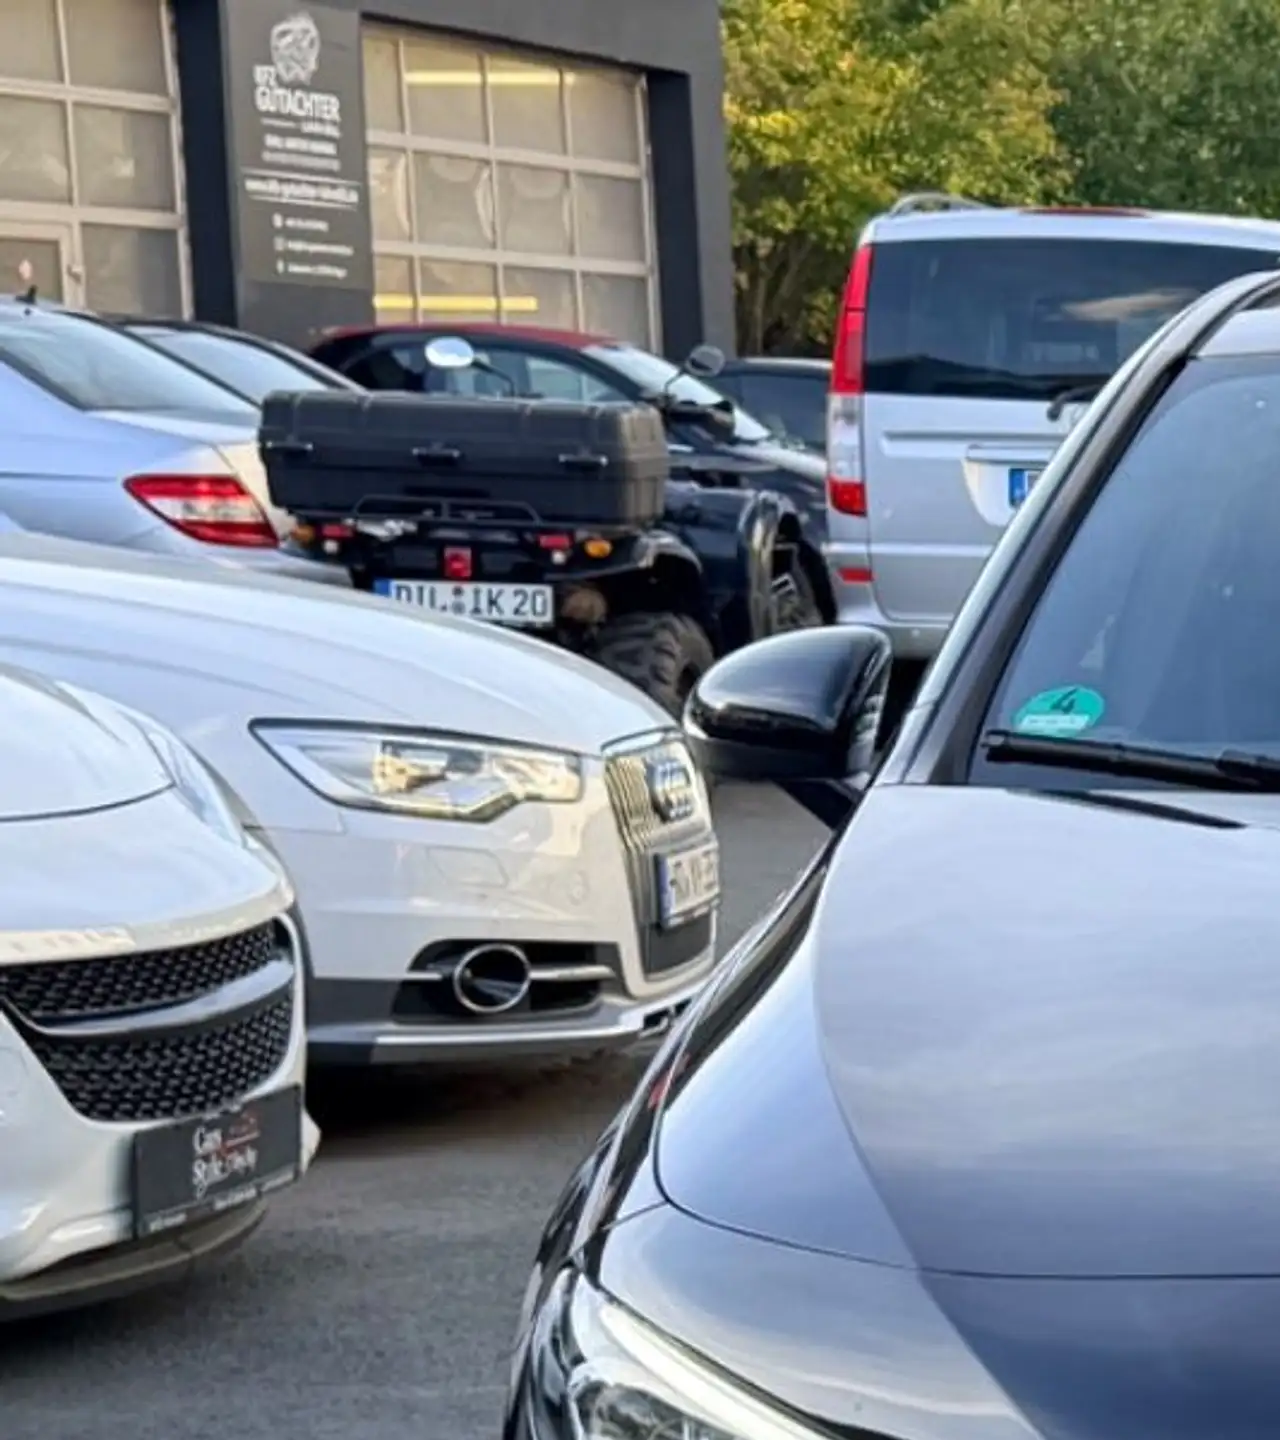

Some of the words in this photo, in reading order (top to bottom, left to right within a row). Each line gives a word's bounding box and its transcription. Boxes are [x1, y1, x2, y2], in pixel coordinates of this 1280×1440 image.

[469, 586, 506, 616] IK
[512, 588, 548, 618] 20
[1049, 687, 1078, 715] 4
